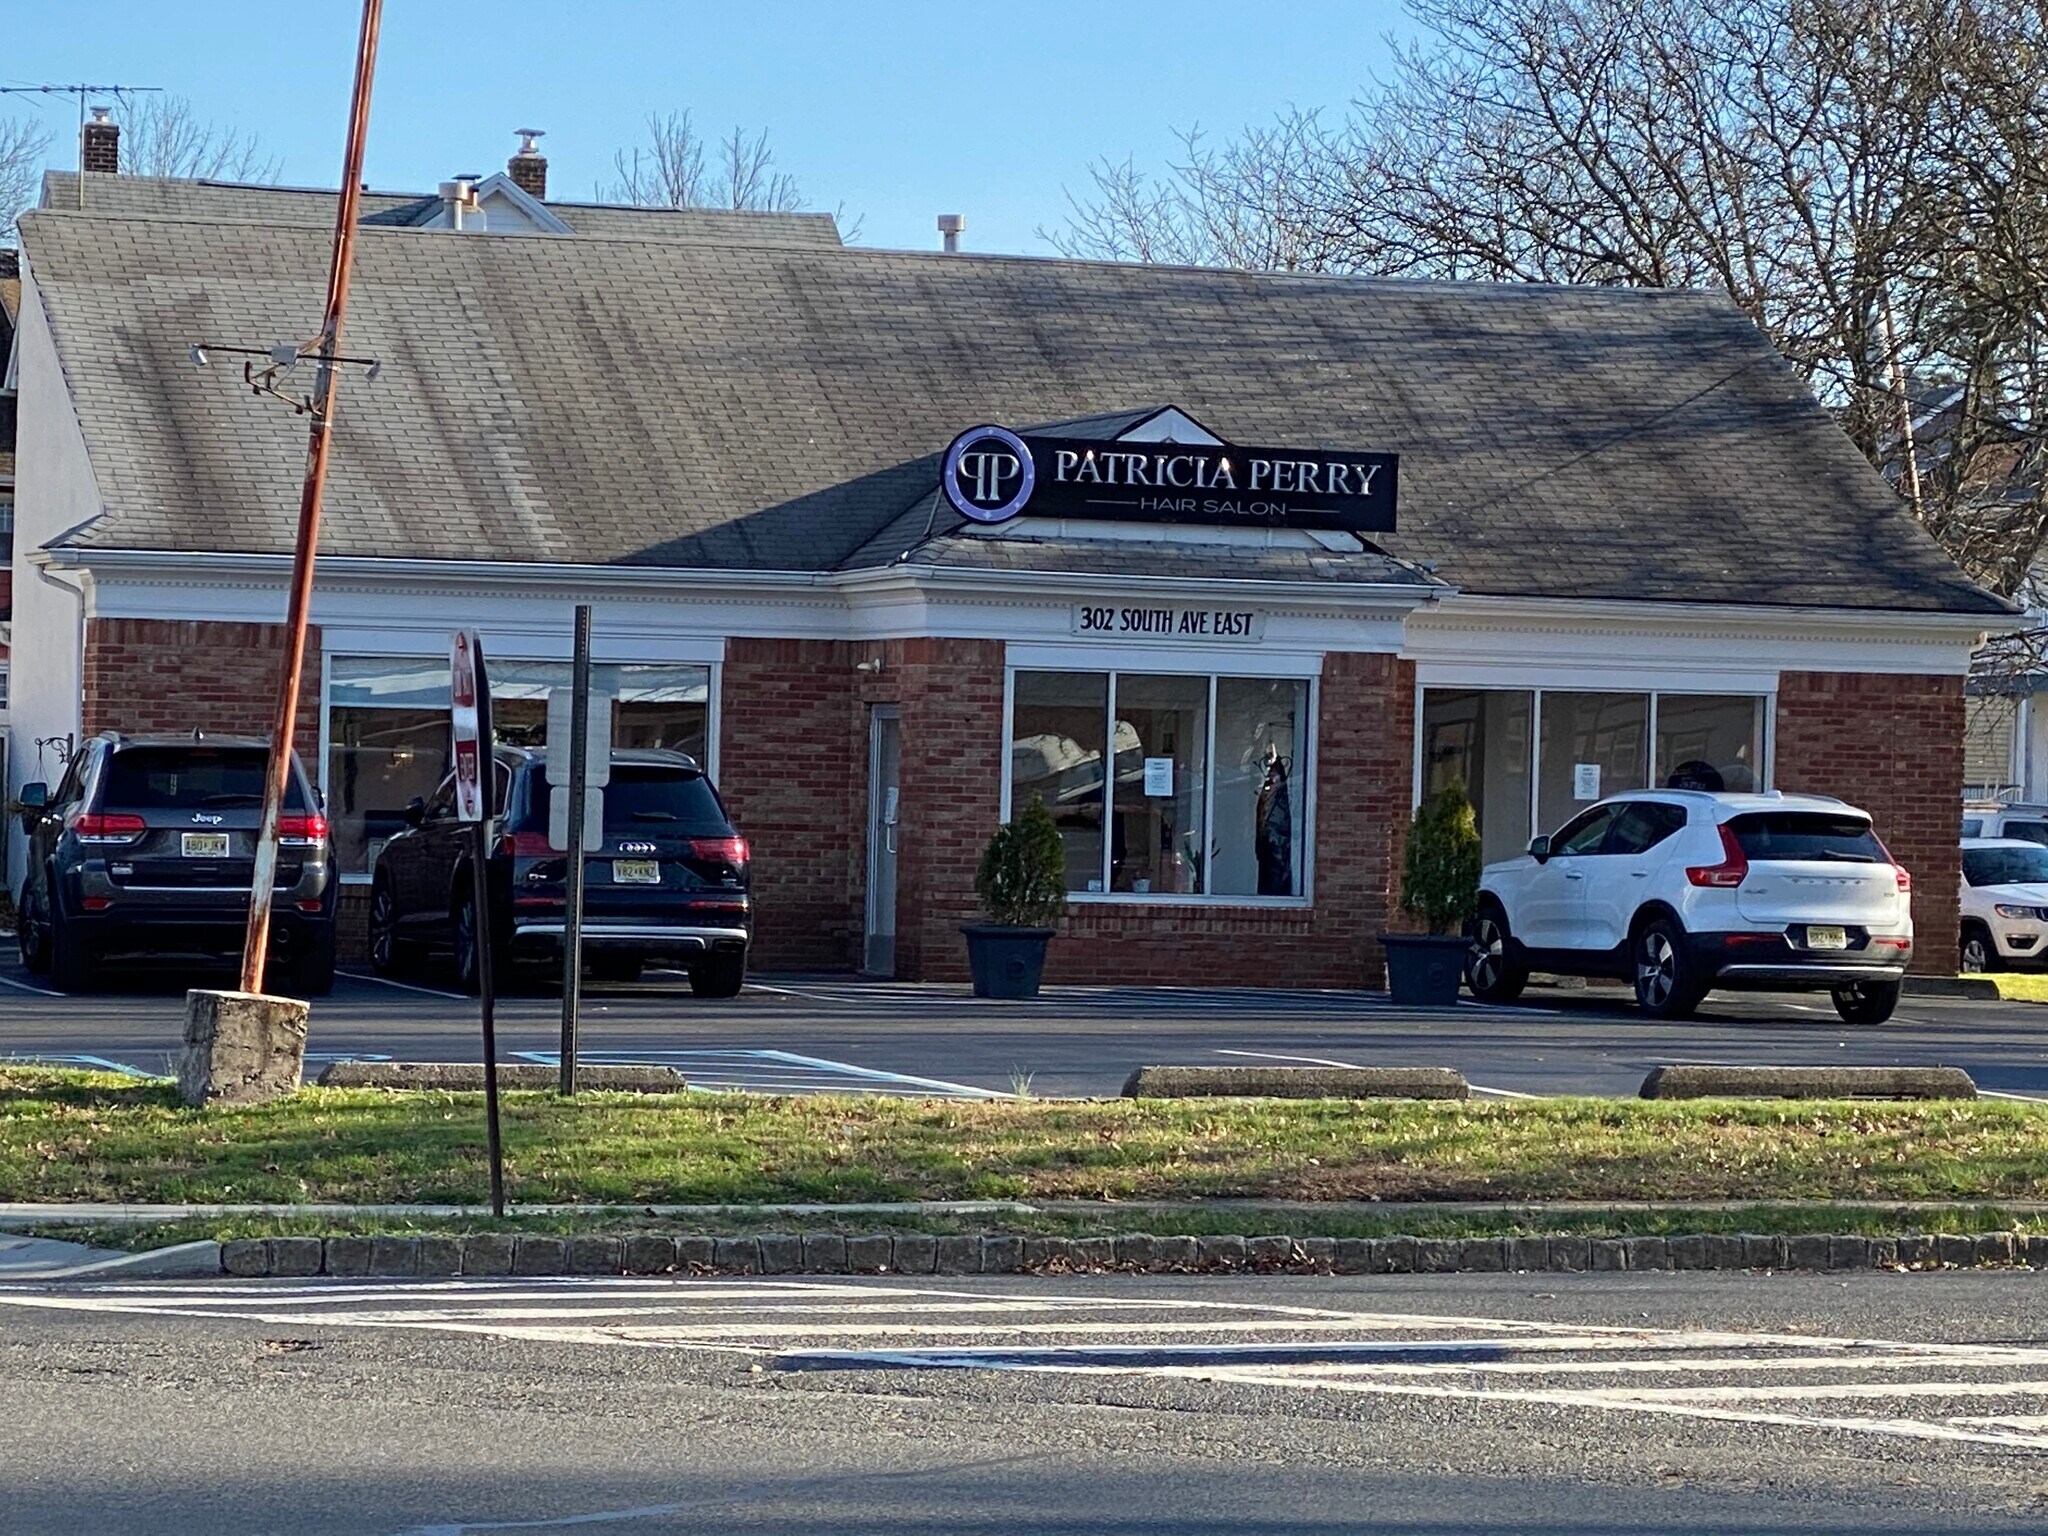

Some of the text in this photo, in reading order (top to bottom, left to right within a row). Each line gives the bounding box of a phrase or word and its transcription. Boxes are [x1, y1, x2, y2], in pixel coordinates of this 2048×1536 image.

[1054, 450, 1381, 495] PATRICIA PERRY
[1141, 497, 1286, 515] HAIR SALON
[1080, 607, 1253, 636] 302 SOUTH AVE EAST
[191, 813, 222, 825] Jeep
